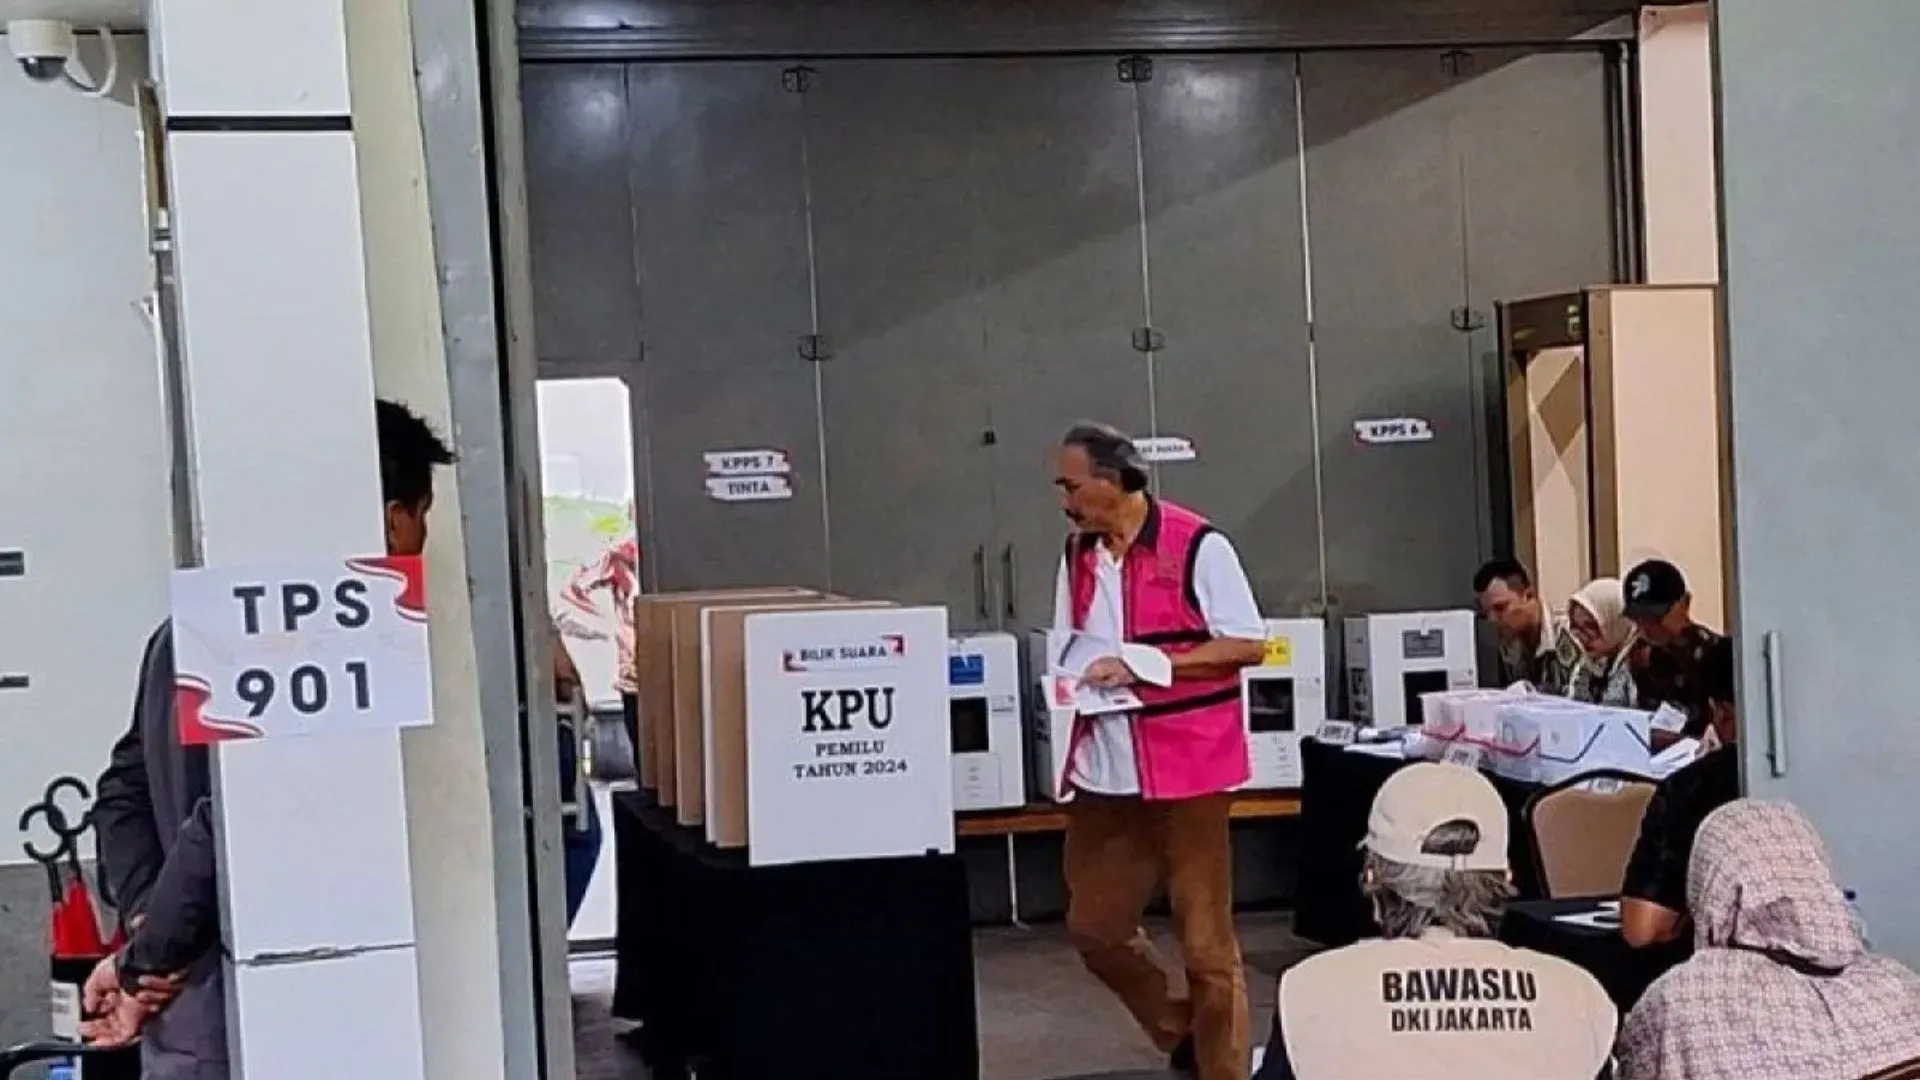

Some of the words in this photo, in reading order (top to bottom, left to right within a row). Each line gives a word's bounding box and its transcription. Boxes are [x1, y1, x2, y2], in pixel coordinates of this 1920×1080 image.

[728, 481, 771, 495] TINTA
[232, 579, 370, 635] TPS
[801, 648, 835, 661] BILIK
[840, 646, 888, 660] SUARA
[236, 661, 370, 717] 901
[801, 687, 894, 732] KPU
[815, 740, 884, 757] PEMILU
[793, 762, 857, 778] TAHUN
[863, 759, 908, 774] 2024
[1382, 969, 1537, 1002] BAWASLU
[1391, 1008, 1430, 1032] DKI
[1434, 1007, 1532, 1032] JAKARTA
